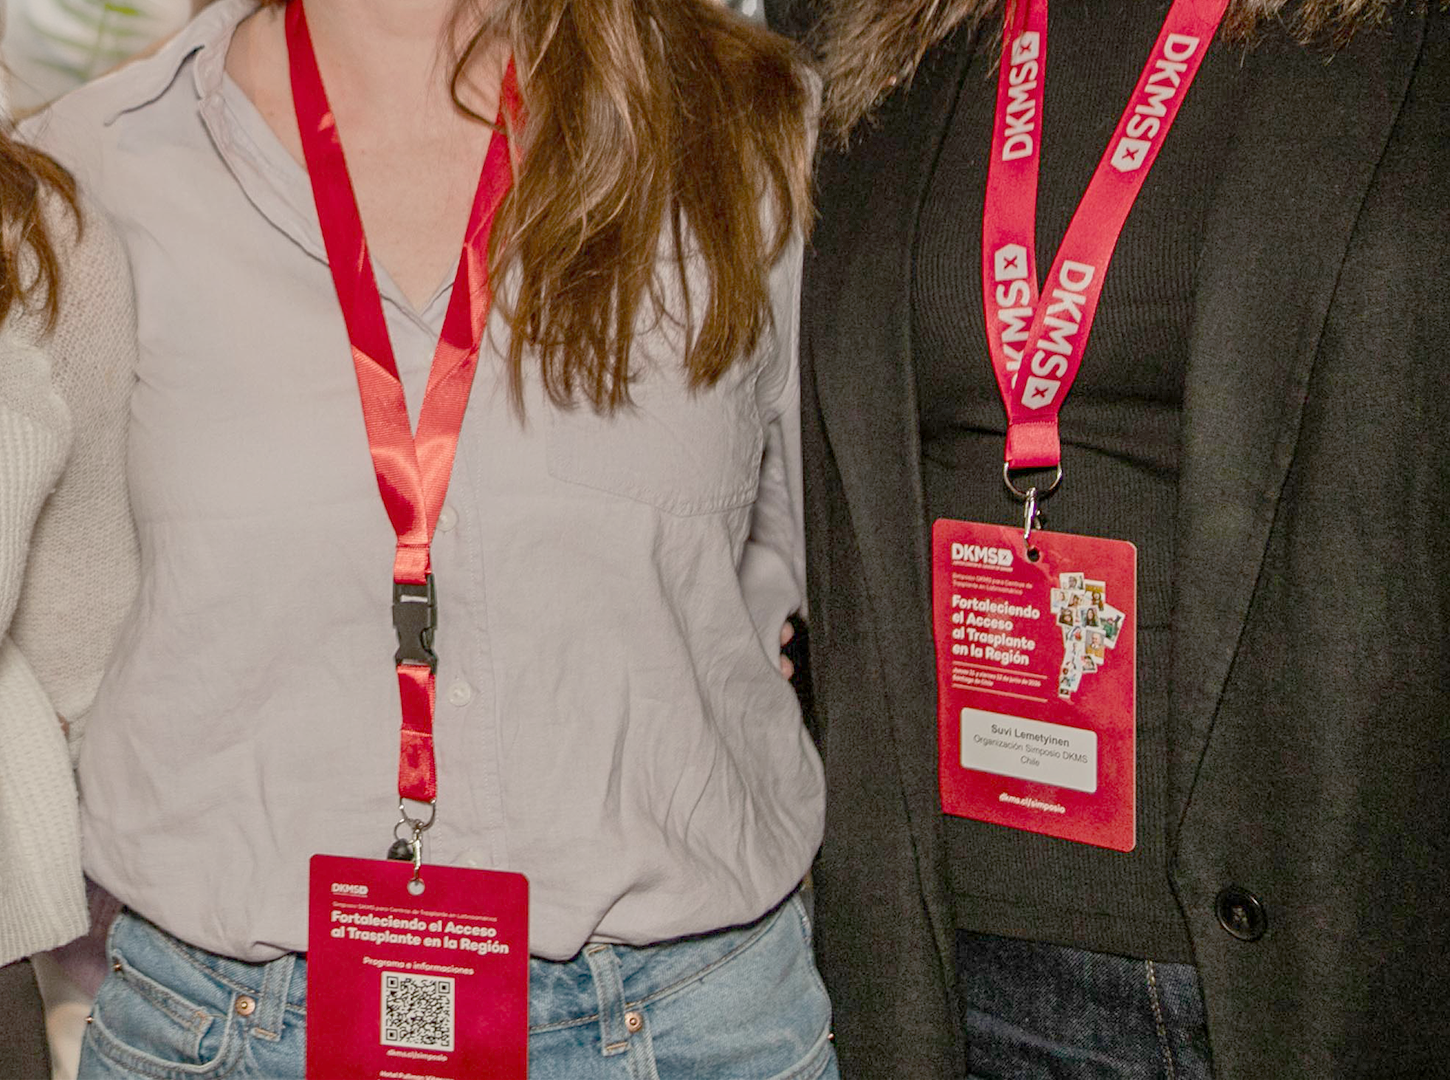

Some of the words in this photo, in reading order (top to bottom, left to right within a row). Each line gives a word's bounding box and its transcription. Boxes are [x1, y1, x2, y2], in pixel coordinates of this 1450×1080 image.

[1126, 32, 1200, 140] DKMS
[1002, 60, 1039, 161] DKMS
[1031, 260, 1095, 379] DKMS
[952, 543, 999, 564] DKMS
[952, 595, 1040, 619] Fortaleciendo
[952, 612, 964, 624] el
[966, 613, 1013, 631] Acceso
[952, 627, 964, 640] al
[967, 628, 1035, 651] Trasplante
[952, 644, 969, 655] en
[971, 644, 983, 657] la
[985, 647, 1029, 666] Región
[991, 724, 1012, 737] Suvi
[1015, 728, 1070, 748] Lemetyinen
[973, 734, 1023, 751] Organización
[1025, 744, 1060, 759] Simposio
[1063, 751, 1088, 764] DKMS
[1020, 755, 1040, 767] Chile
[331, 882, 361, 894] DKMS
[331, 910, 427, 931] Fortaleciendo
[428, 919, 442, 932] el
[445, 921, 497, 937] Acceso
[331, 926, 345, 938] al
[347, 926, 421, 945] Trasplante
[423, 936, 442, 948] en
[444, 936, 458, 949] la
[459, 937, 509, 955] Región
[363, 956, 405, 970] Programa
[406, 961, 412, 969] e
[413, 961, 475, 975] informaciones
